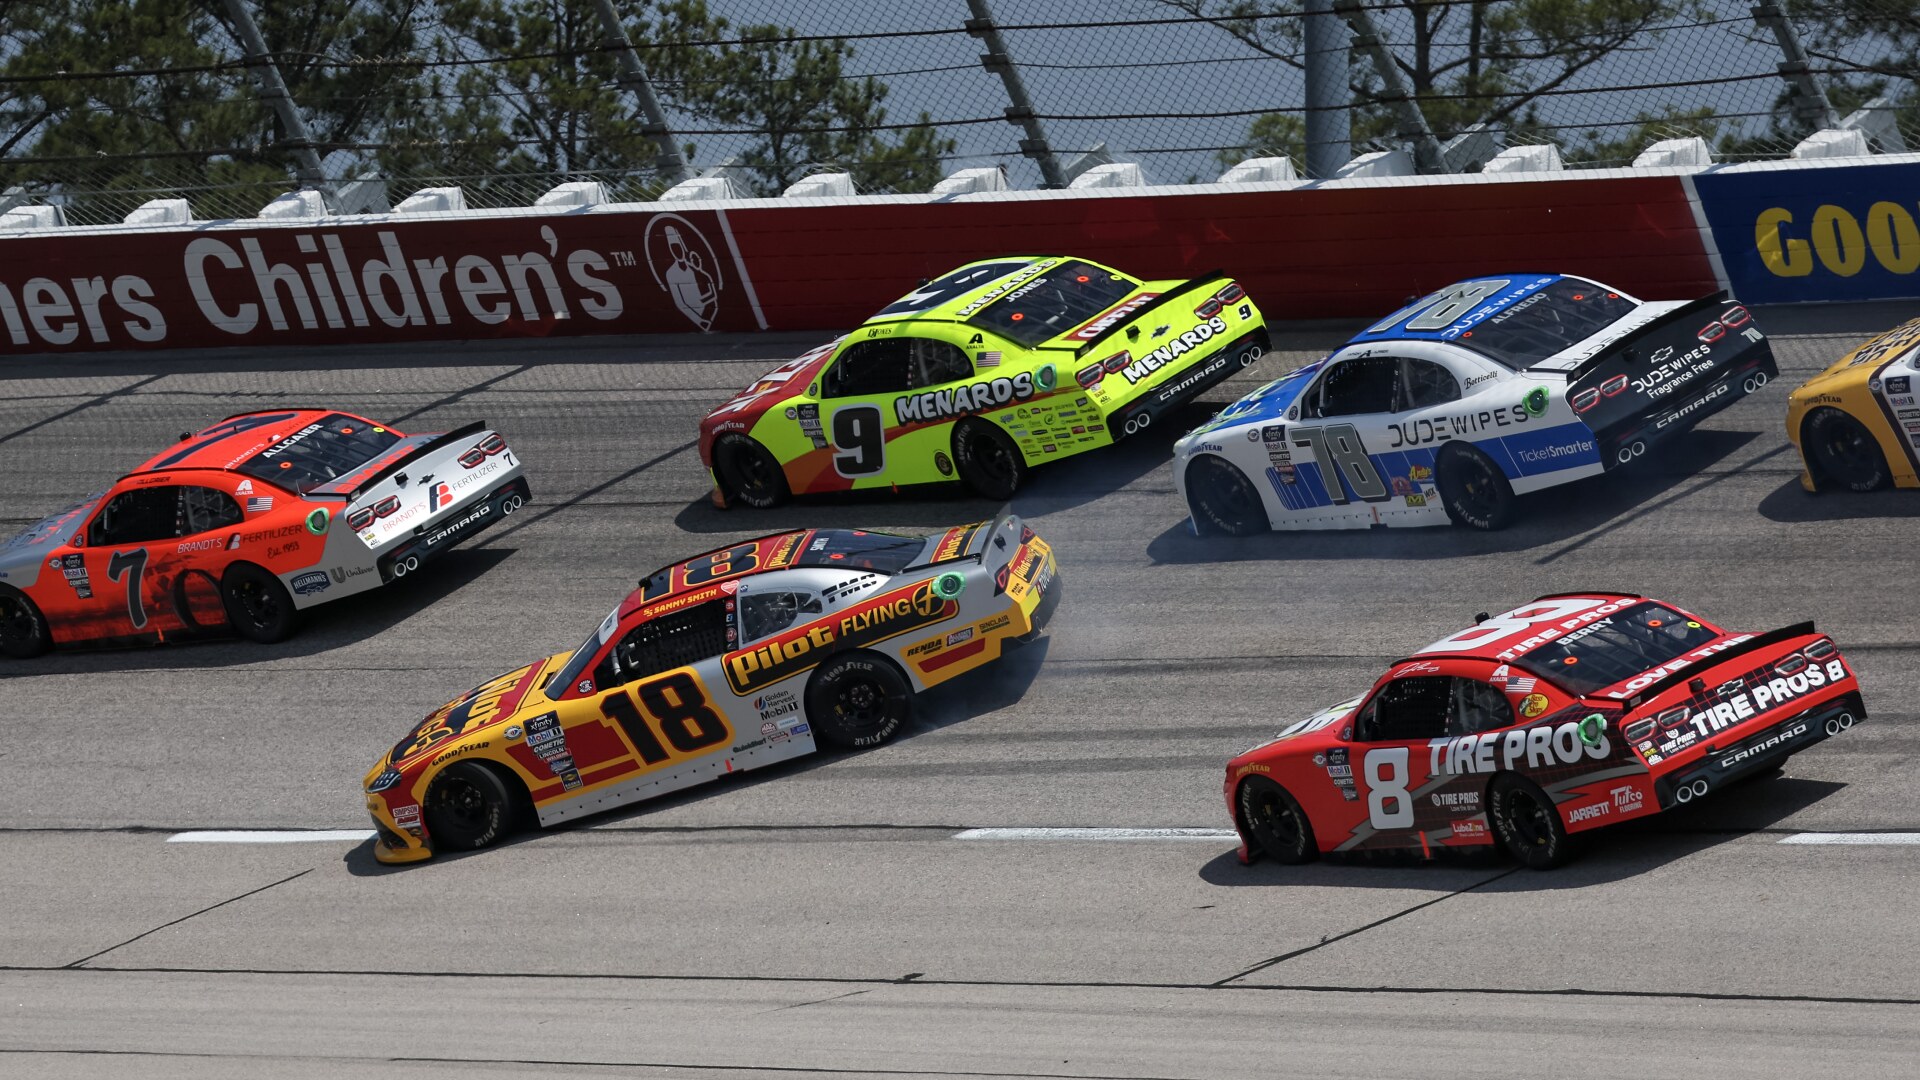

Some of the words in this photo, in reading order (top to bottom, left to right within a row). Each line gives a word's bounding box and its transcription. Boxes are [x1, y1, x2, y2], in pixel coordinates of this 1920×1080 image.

[184, 225, 624, 334] Children's
[955, 259, 1057, 316] MENARDS
[1004, 277, 1048, 302] JONES
[1238, 303, 1252, 320] 9
[1441, 304, 1499, 338] DUDE
[1496, 277, 1552, 306] WIPES
[1490, 292, 1548, 325] ALFREDO
[1122, 316, 1226, 385] MENARDS
[1159, 357, 1226, 402] CAMARO
[1631, 365, 1675, 393] DUDE
[1672, 344, 1711, 371] WIPES
[1647, 371, 1693, 399] Fragrance
[1692, 359, 1714, 376] Free
[894, 371, 1034, 427] MENARDS
[1656, 384, 1728, 429] CAMARO
[262, 423, 324, 458] ALLGAIER
[831, 403, 885, 479] 9
[1388, 416, 1451, 448] DUDE
[1451, 405, 1529, 435] WIPES
[503, 452, 515, 467] 7
[1288, 423, 1389, 502] 78
[1518, 440, 1593, 463] TicketSmarter
[382, 502, 426, 532] BRANDT'S
[452, 462, 498, 491] FERTILIZER
[177, 537, 223, 553] BRANDT'S
[241, 525, 303, 543] FERTILIZER
[427, 506, 491, 546] CAMARO
[107, 546, 149, 629] 7
[654, 597, 686, 612] SAMMY
[687, 589, 717, 605] SMITH
[841, 598, 911, 637] FLYING
[979, 615, 1009, 630] SINCLAIR
[1495, 628, 1562, 660] TIRE
[1560, 598, 1637, 630] PROS
[1556, 617, 1614, 646] BERRY
[907, 639, 942, 656] RENDA
[1608, 658, 1691, 699] LOVE
[1825, 658, 1845, 682] 8
[760, 705, 788, 720] Mobil
[765, 690, 789, 702] Golden
[767, 695, 794, 708] Harvest
[1690, 693, 1756, 737] TIRE
[1753, 662, 1826, 710] PROS
[531, 718, 553, 730] xfinity
[599, 671, 732, 765] 18
[432, 741, 490, 766] GOODYEAR
[528, 732, 552, 745] Mobil
[534, 738, 565, 752] COMETIC
[539, 747, 565, 759] LINCOLN
[1427, 732, 1500, 776] TIRE
[1660, 739, 1677, 753] TIRE
[1676, 730, 1697, 746] PROS
[1721, 723, 1807, 768] CAMARO
[1364, 747, 1415, 830] 8
[1440, 793, 1458, 805] TIRE
[1459, 791, 1479, 804] PROS
[1610, 785, 1643, 807] Tufco
[394, 806, 419, 816] SIMPSON
[1569, 801, 1610, 823] JARRETT
[1619, 800, 1643, 814] FLOORING
